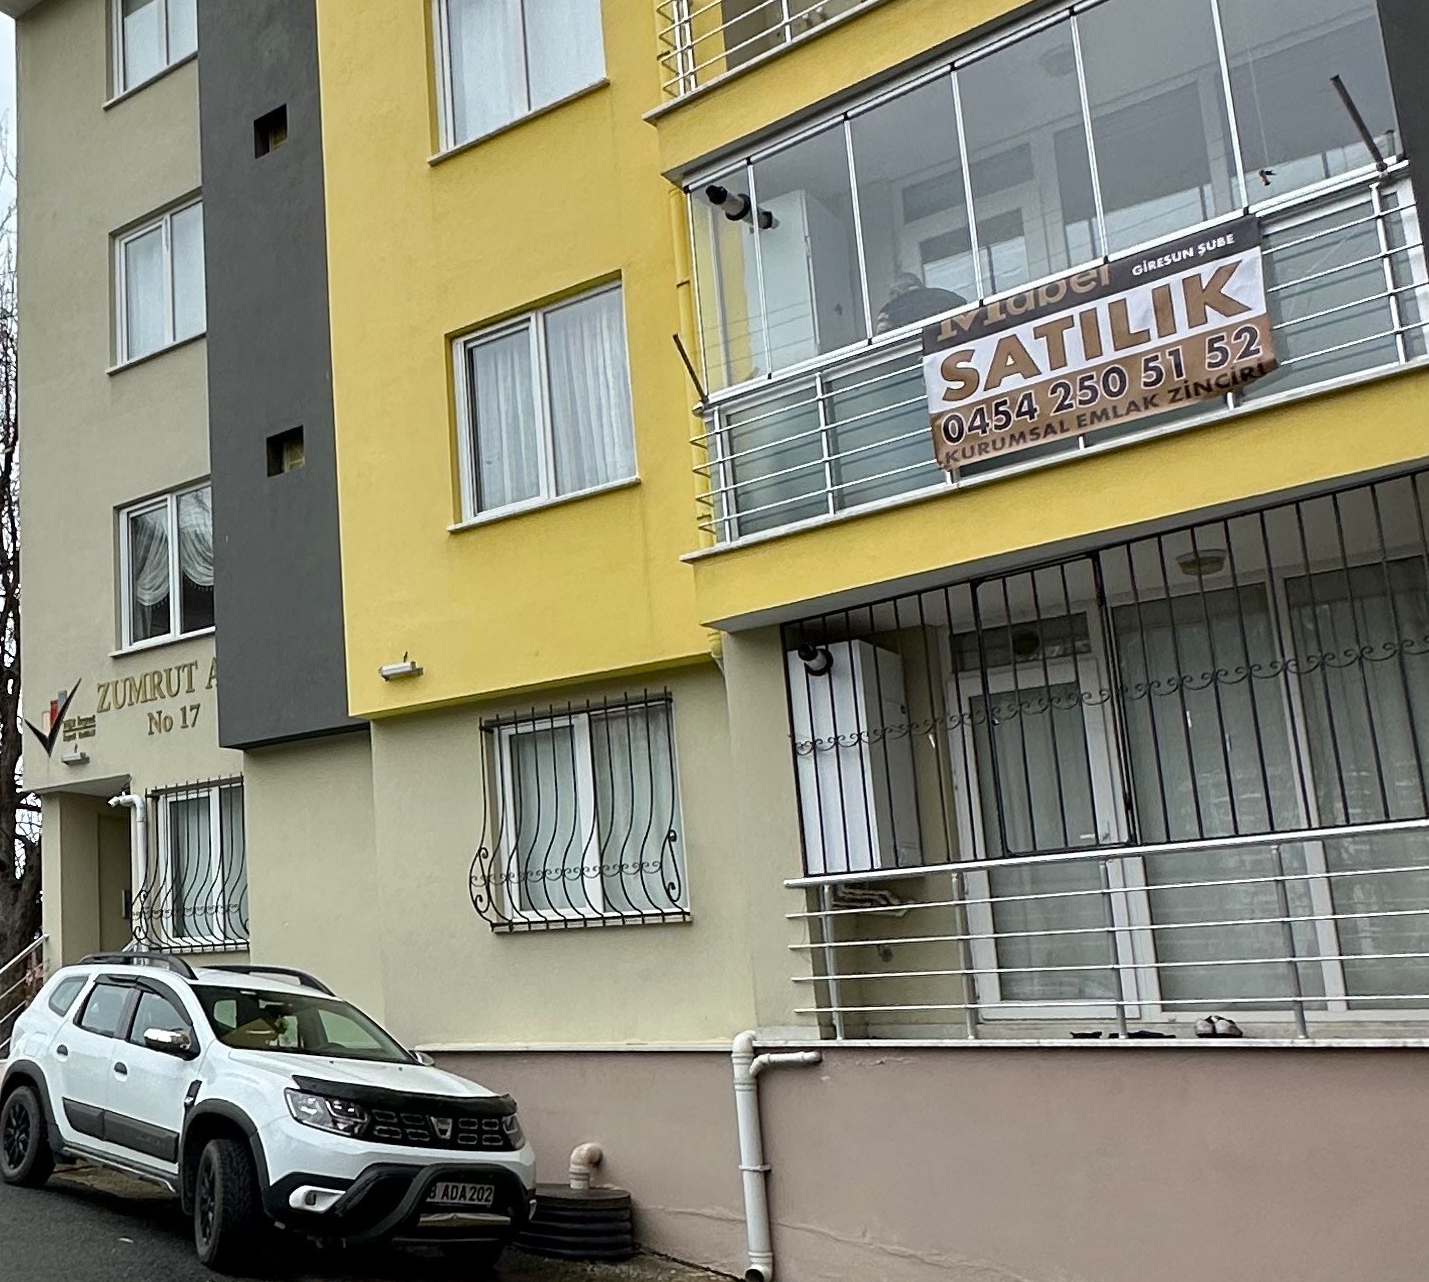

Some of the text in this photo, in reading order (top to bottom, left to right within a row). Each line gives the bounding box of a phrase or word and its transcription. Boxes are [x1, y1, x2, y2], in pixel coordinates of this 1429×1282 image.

[1132, 233, 1235, 276] GİRESUN ŞUBE
[940, 259, 1253, 402] SATILIK
[942, 324, 1263, 445] 0454 250 51 52
[945, 420, 1070, 464] KURUMSAL
[1076, 393, 1159, 429] EMLAK
[147, 703, 201, 736] No 17
[441, 1184, 467, 1200] ADA
[468, 1185, 493, 1202] 202
